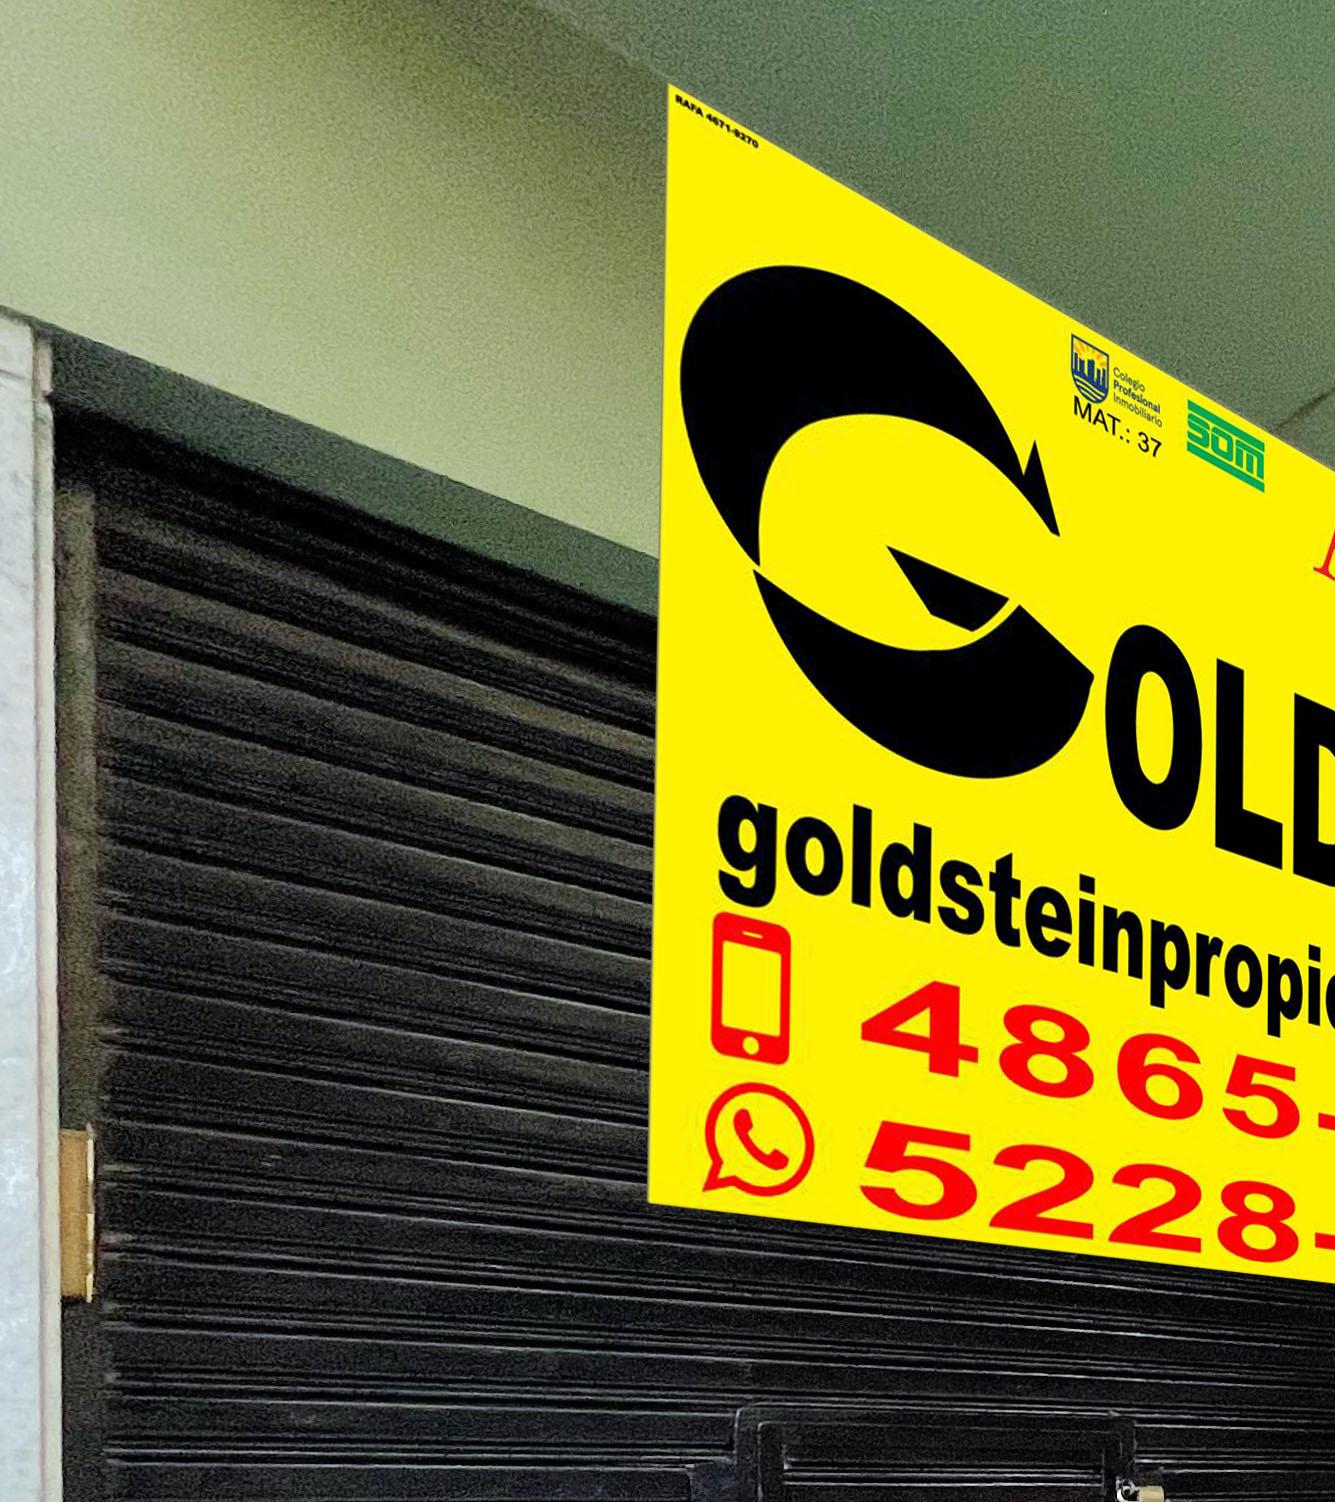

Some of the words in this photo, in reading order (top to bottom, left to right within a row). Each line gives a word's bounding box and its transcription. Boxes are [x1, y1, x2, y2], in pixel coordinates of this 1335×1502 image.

[1113, 367, 1146, 393] Colegio
[1113, 379, 1161, 415] Profesional
[1113, 392, 1163, 428] Inmobiliario
[1137, 431, 1163, 458] 37
